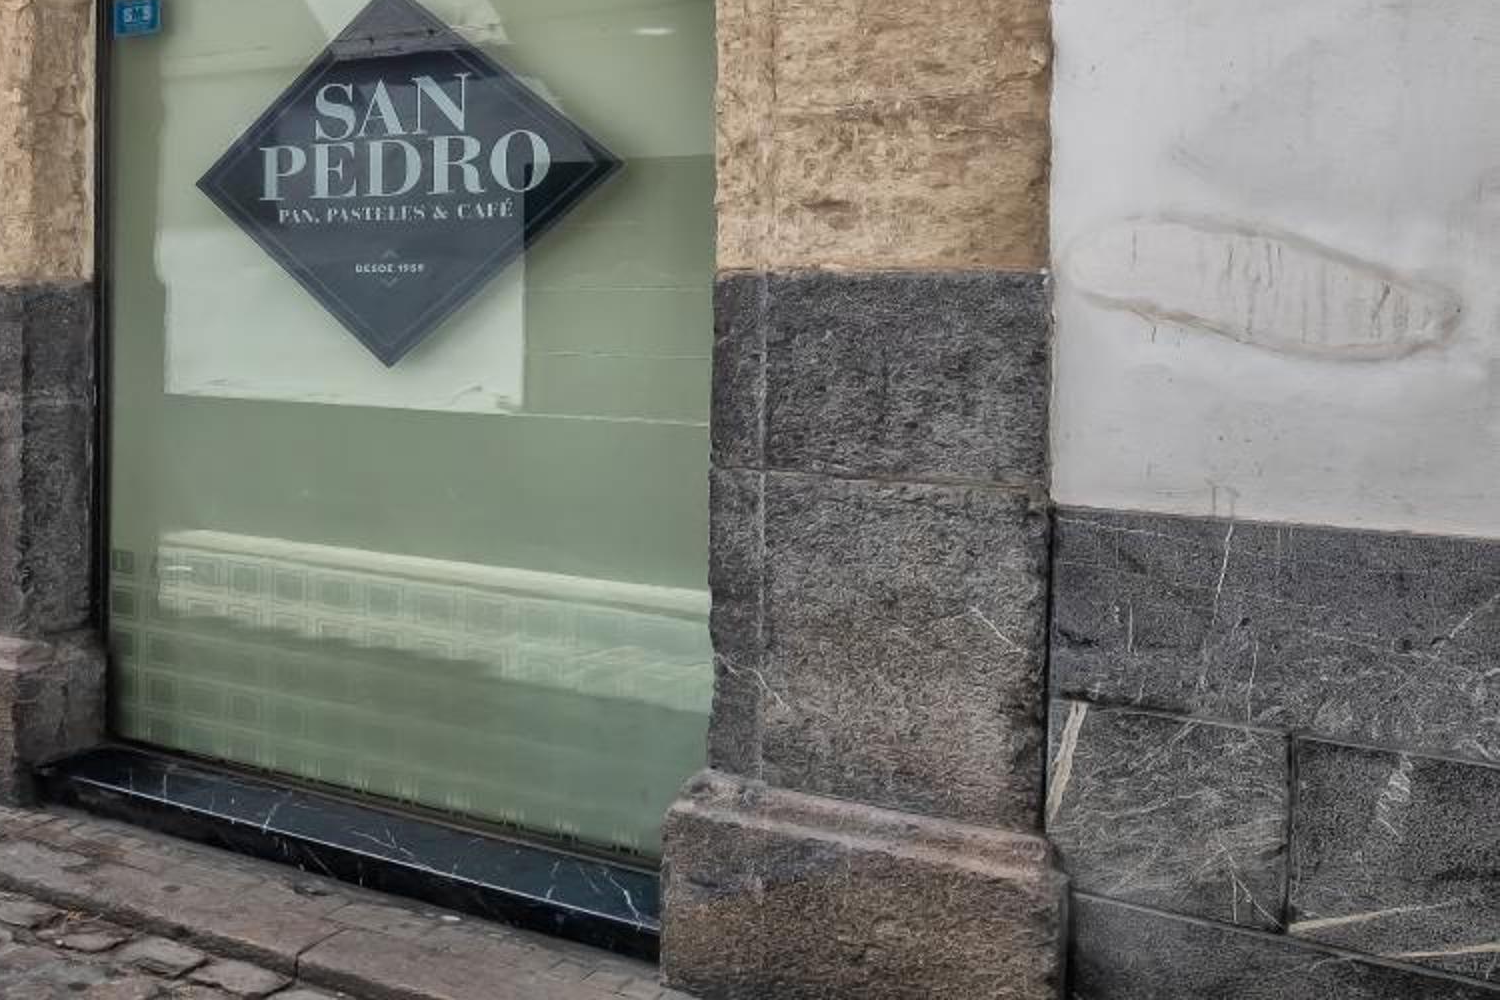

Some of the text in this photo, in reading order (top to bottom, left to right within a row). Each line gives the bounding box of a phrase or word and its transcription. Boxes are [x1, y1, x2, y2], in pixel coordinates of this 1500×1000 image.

[315, 72, 471, 141] SAN
[259, 129, 551, 201] PEDRO
[327, 205, 426, 223] PASTELES
[433, 204, 449, 220] &
[458, 197, 514, 219] CAFÉ
[355, 263, 393, 273] DESDE
